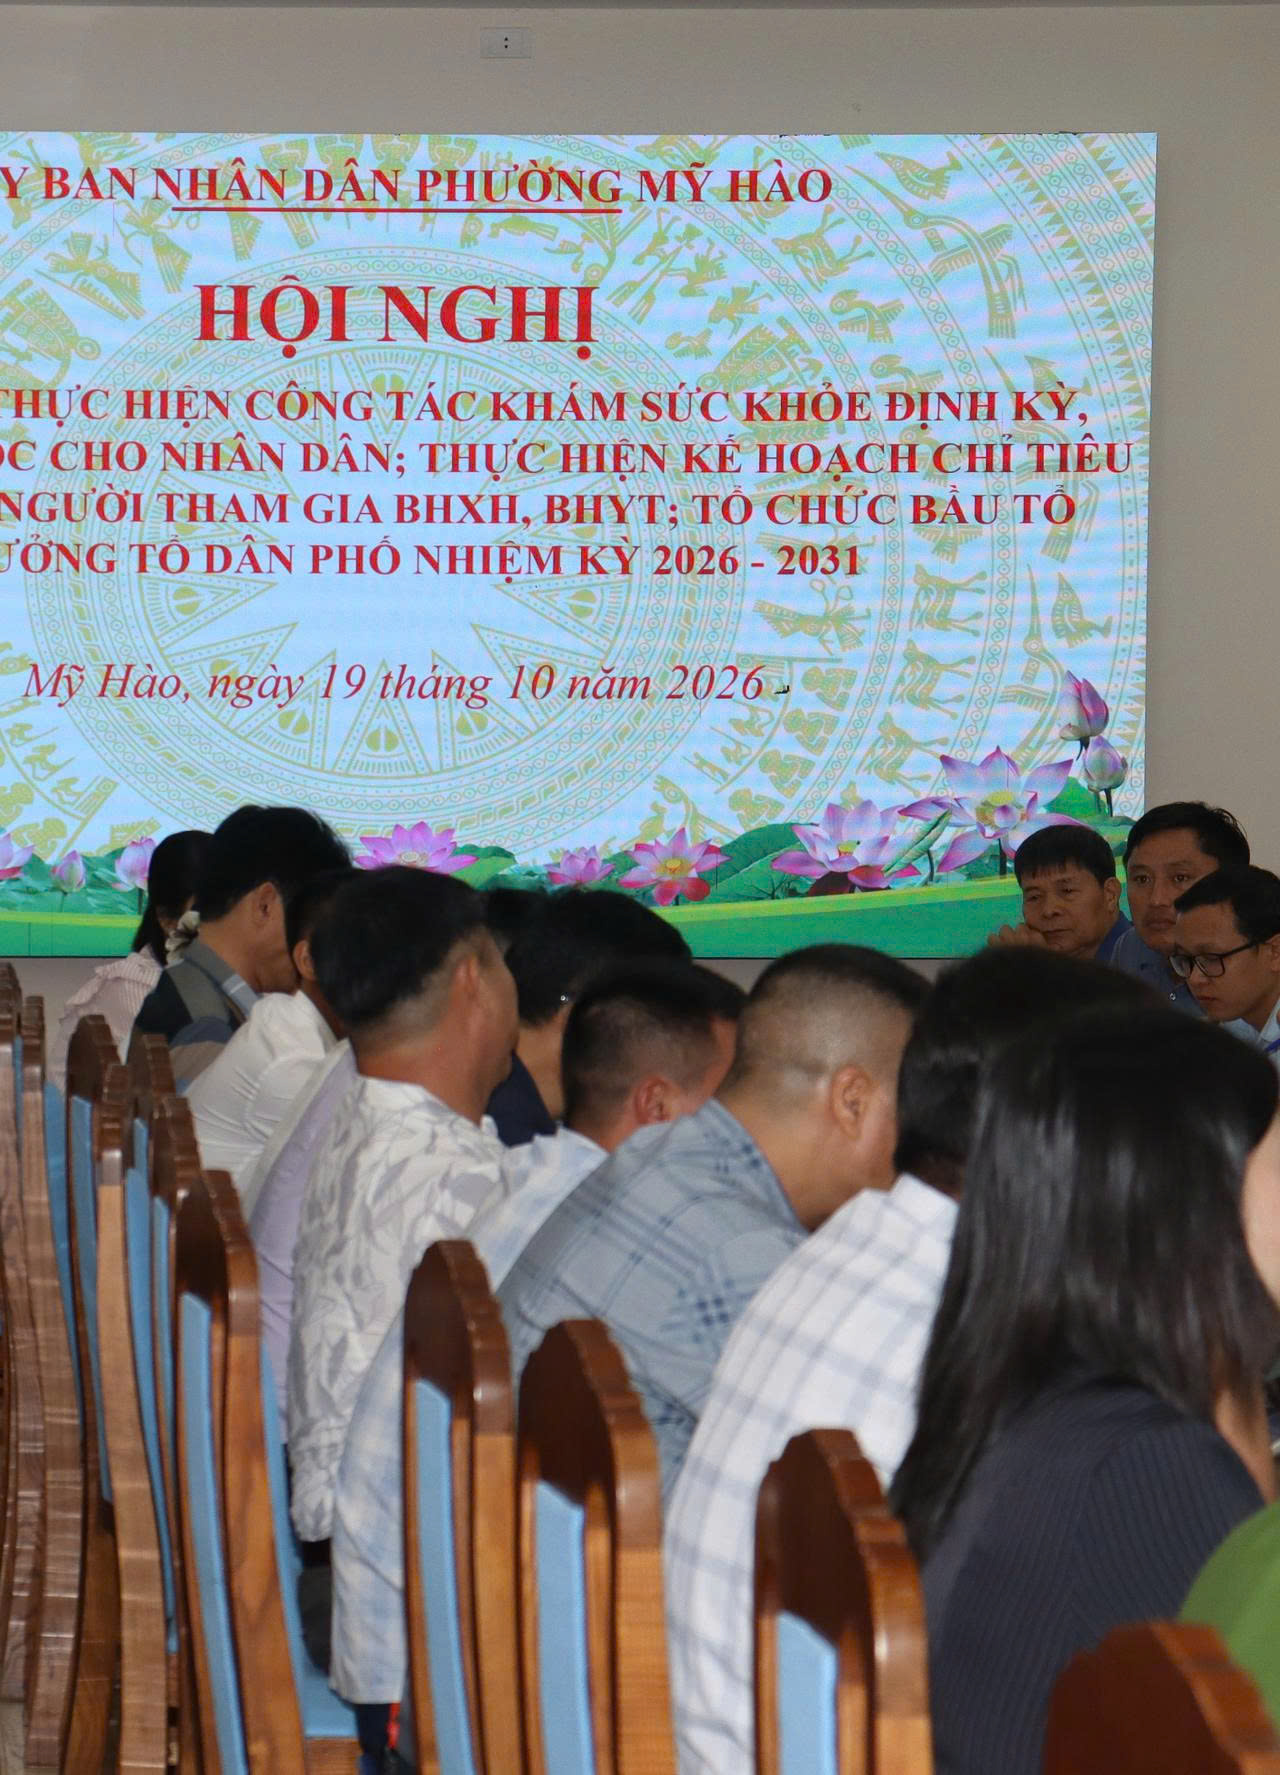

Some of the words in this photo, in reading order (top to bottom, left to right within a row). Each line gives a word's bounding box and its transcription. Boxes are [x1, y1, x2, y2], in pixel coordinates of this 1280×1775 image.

[44, 166, 138, 201] BAN
[155, 157, 286, 202] NHÂN
[304, 157, 400, 203] DÂN
[418, 160, 622, 205] PHƯỜNG
[639, 162, 714, 204] MỸ
[728, 160, 833, 205] HÀO
[194, 275, 353, 359] HỘI
[378, 284, 599, 361] NGHỊ
[124, 385, 231, 429] HIỆN
[245, 380, 373, 422] CÔNG
[386, 383, 477, 423] TÁC
[491, 381, 627, 423] KHÁM
[640, 382, 732, 423] SỨC
[743, 382, 872, 424] KHỎE
[886, 391, 998, 431] ĐỊNH
[1013, 382, 1089, 427] KỲ,
[50, 440, 148, 473] CHO
[162, 432, 285, 474] NHÂN
[302, 433, 406, 478] DÂN;
[419, 440, 545, 482] THỰC
[561, 438, 668, 482] HIỆN
[682, 433, 743, 475] KẾ
[756, 442, 919, 481] HOẠCH
[932, 432, 1013, 475] CHỈ
[1026, 432, 1134, 475] TIÊU
[157, 492, 289, 524] THAM
[303, 493, 383, 525] GIA
[395, 494, 533, 531] BHXH,
[545, 494, 680, 531] BHYT;
[692, 484, 754, 526] TỔ
[765, 486, 897, 526] CHỨC
[911, 482, 1001, 526] BẦU
[1012, 484, 1077, 527] TỔ
[128, 533, 191, 575] TỔ
[204, 533, 296, 576] DÂN
[310, 533, 401, 575] PHỐ
[415, 541, 563, 584] NHIỆM
[578, 535, 640, 577] KỲ
[653, 544, 740, 577] 2026
[778, 543, 862, 577] 2031
[24, 662, 86, 708] Mỹ
[97, 662, 192, 707] Hào,
[207, 663, 306, 710] ngày
[322, 663, 368, 700] 19
[380, 663, 492, 711] tháng
[511, 663, 556, 701] 10
[567, 666, 652, 701] năm
[666, 663, 765, 701] 2026
